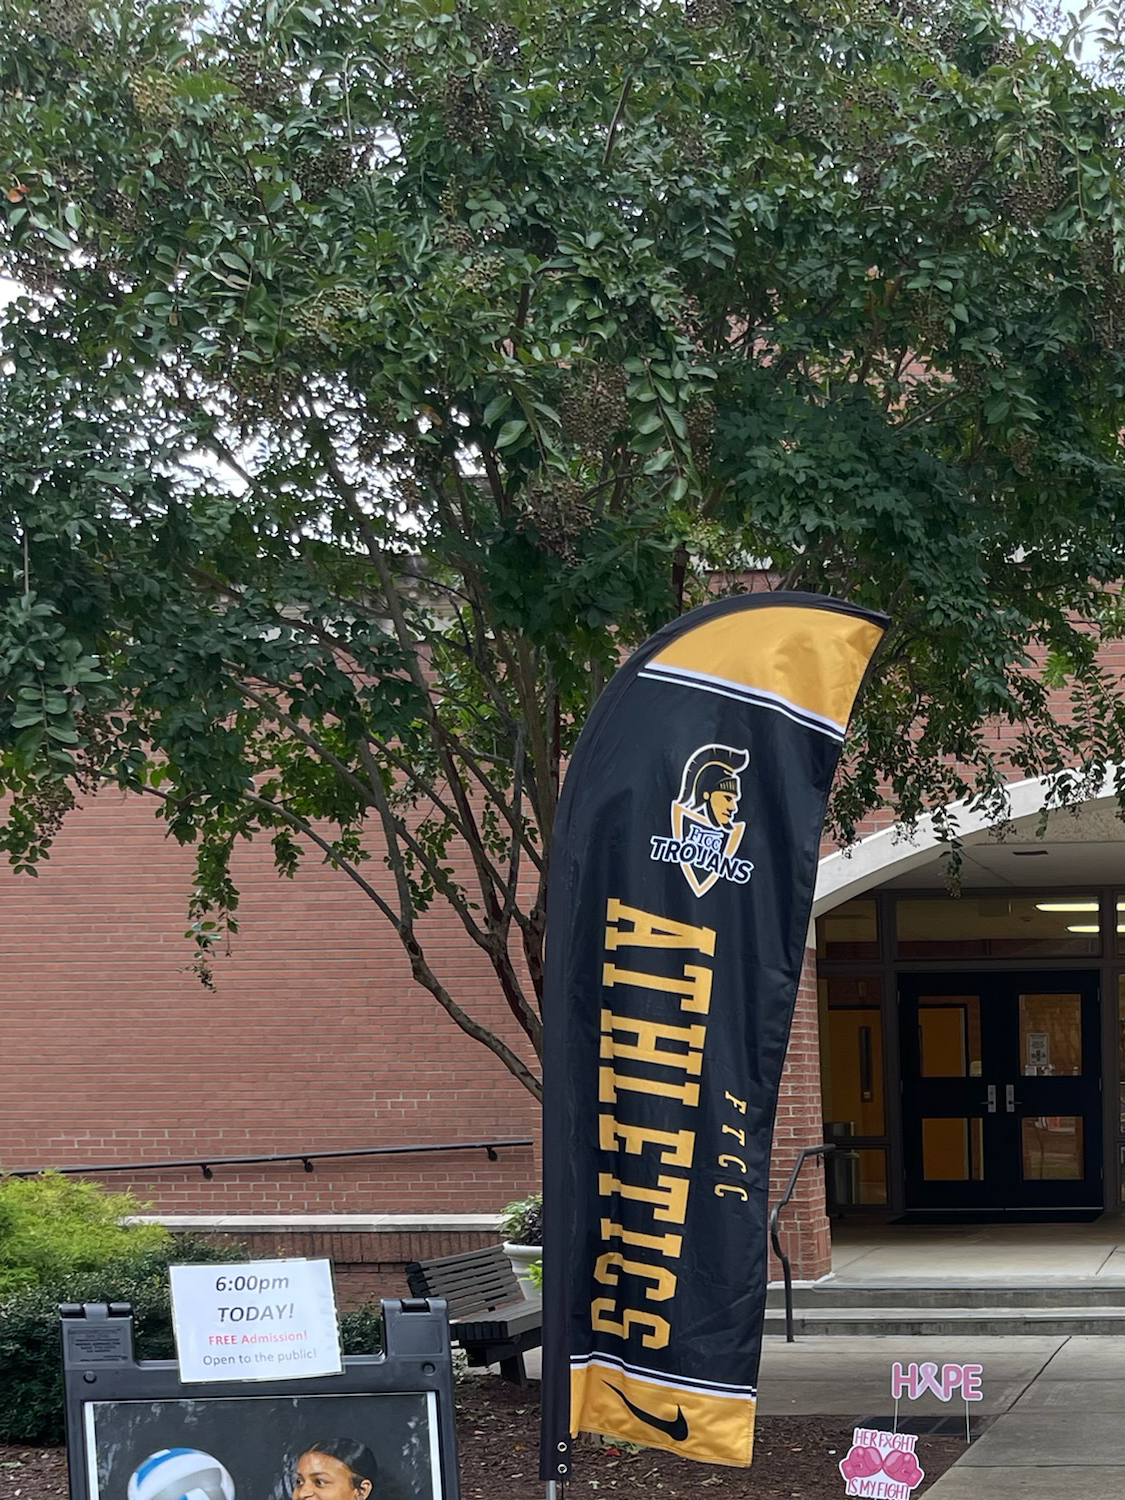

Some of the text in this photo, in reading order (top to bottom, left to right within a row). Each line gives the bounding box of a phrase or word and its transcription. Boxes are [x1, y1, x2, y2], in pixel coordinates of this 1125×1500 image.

[650, 836, 754, 884] TROJANS
[591, 897, 717, 1350] ATHLETICS
[714, 1090, 749, 1202] FTCC
[215, 1275, 290, 1294] 6:00pm
[217, 1302, 295, 1322] TODAY!
[208, 1330, 308, 1346] FREE Admission!
[203, 1348, 317, 1367] Open to the public!
[855, 1429, 877, 1447] HER
[847, 1478, 910, 1500] IS MY FIGHT
